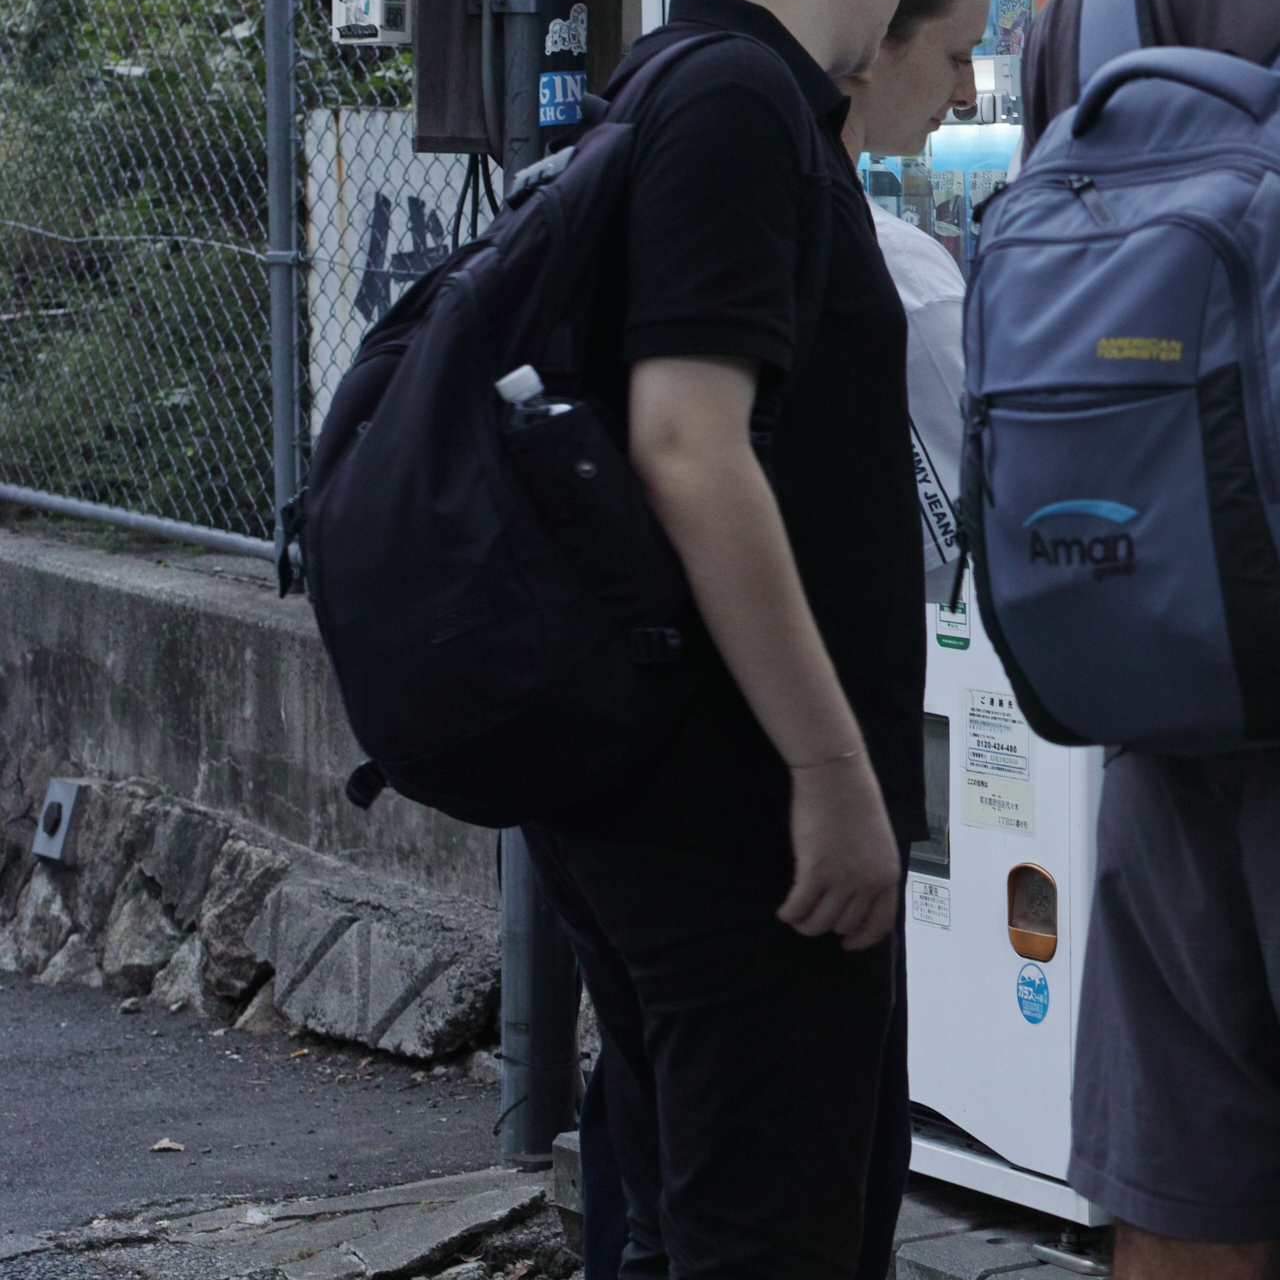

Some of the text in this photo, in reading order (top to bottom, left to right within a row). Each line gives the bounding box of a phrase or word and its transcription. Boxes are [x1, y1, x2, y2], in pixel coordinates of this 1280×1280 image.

[539, 105, 565, 124] KHC
[924, 491, 957, 548] JEANS
[1029, 530, 1134, 566] Aman
[980, 696, 1014, 710] ご連絡先
[976, 739, 1018, 754] 0120-424-480
